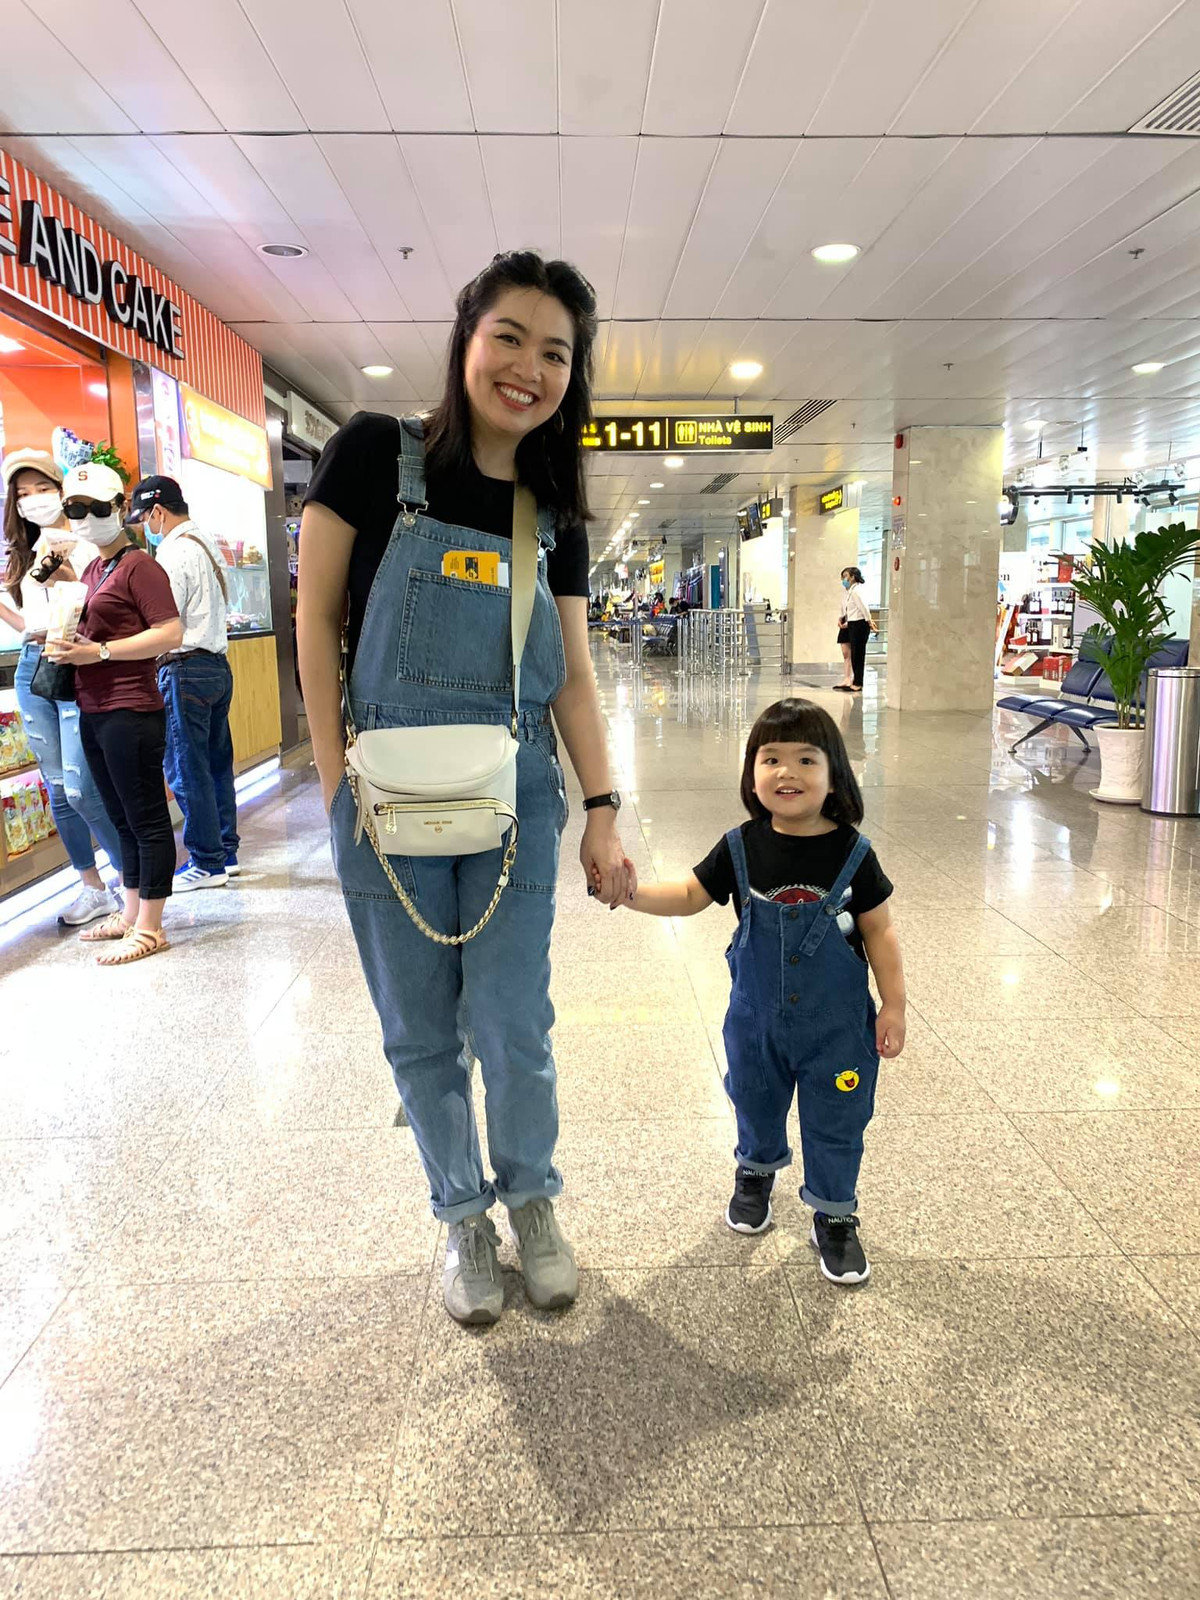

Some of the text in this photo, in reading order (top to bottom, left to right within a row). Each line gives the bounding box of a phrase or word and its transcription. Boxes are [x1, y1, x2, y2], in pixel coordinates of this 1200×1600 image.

[19, 200, 103, 306] AND
[101, 260, 185, 360] CAKE
[699, 419, 723, 433] NHÀ
[744, 421, 772, 433] SINH
[604, 421, 661, 447] 1-11
[699, 436, 732, 446] Toilets
[78, 470, 88, 481] S
